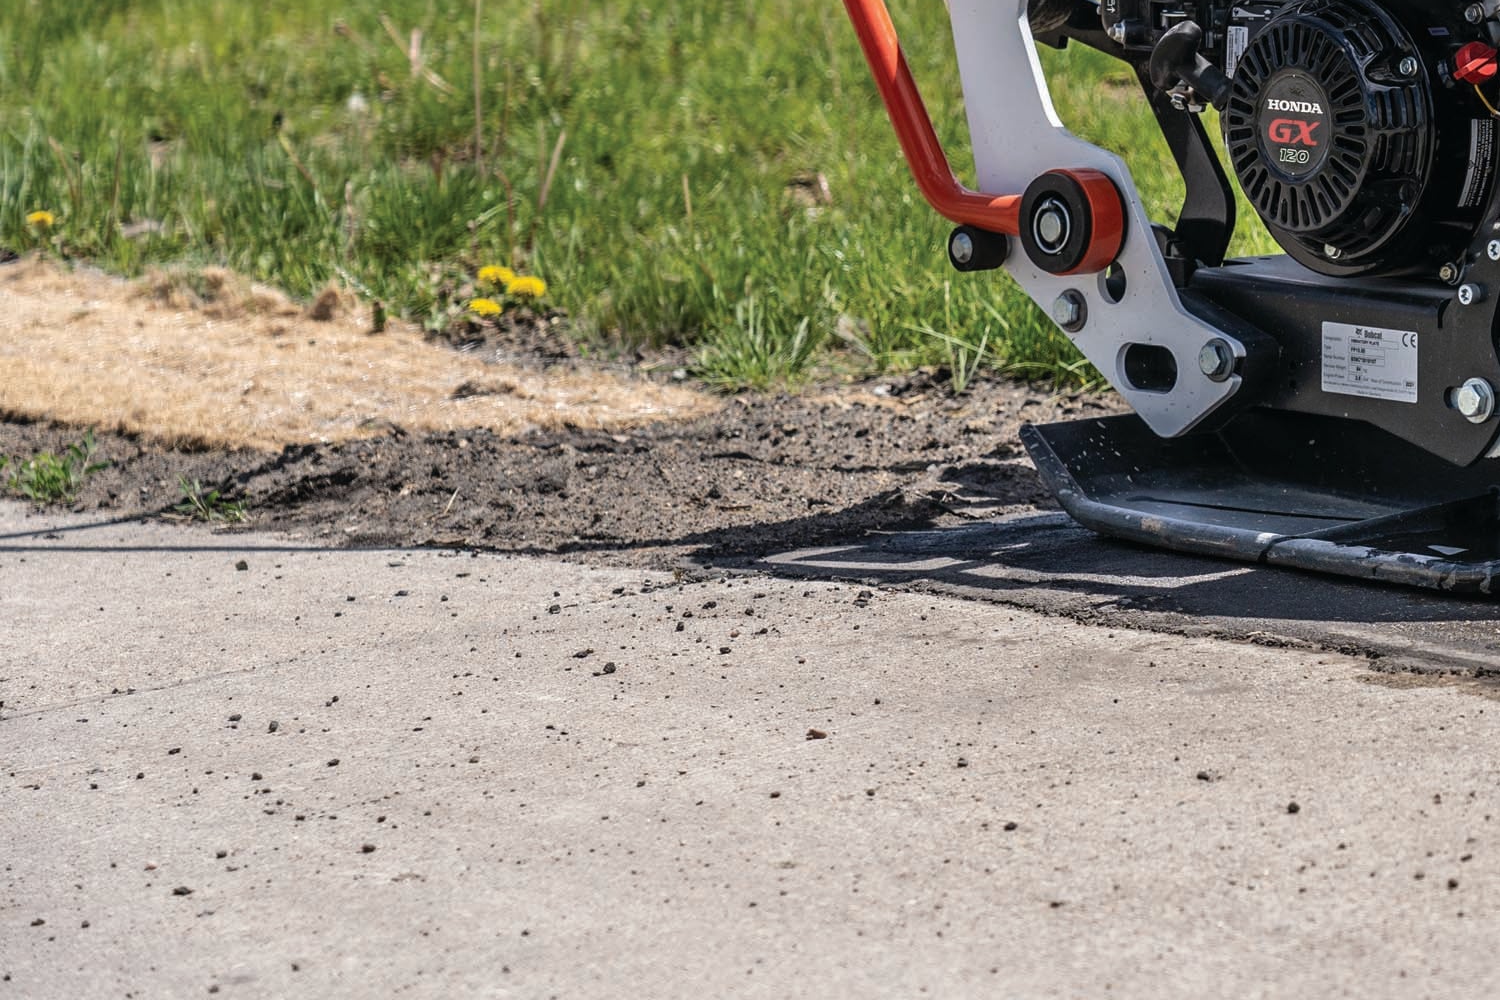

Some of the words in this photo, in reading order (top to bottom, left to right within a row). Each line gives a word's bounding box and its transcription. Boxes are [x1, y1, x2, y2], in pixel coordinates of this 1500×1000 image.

[1267, 98, 1324, 115] HONDA
[1268, 118, 1321, 146] GX
[1279, 147, 1310, 164] 120
